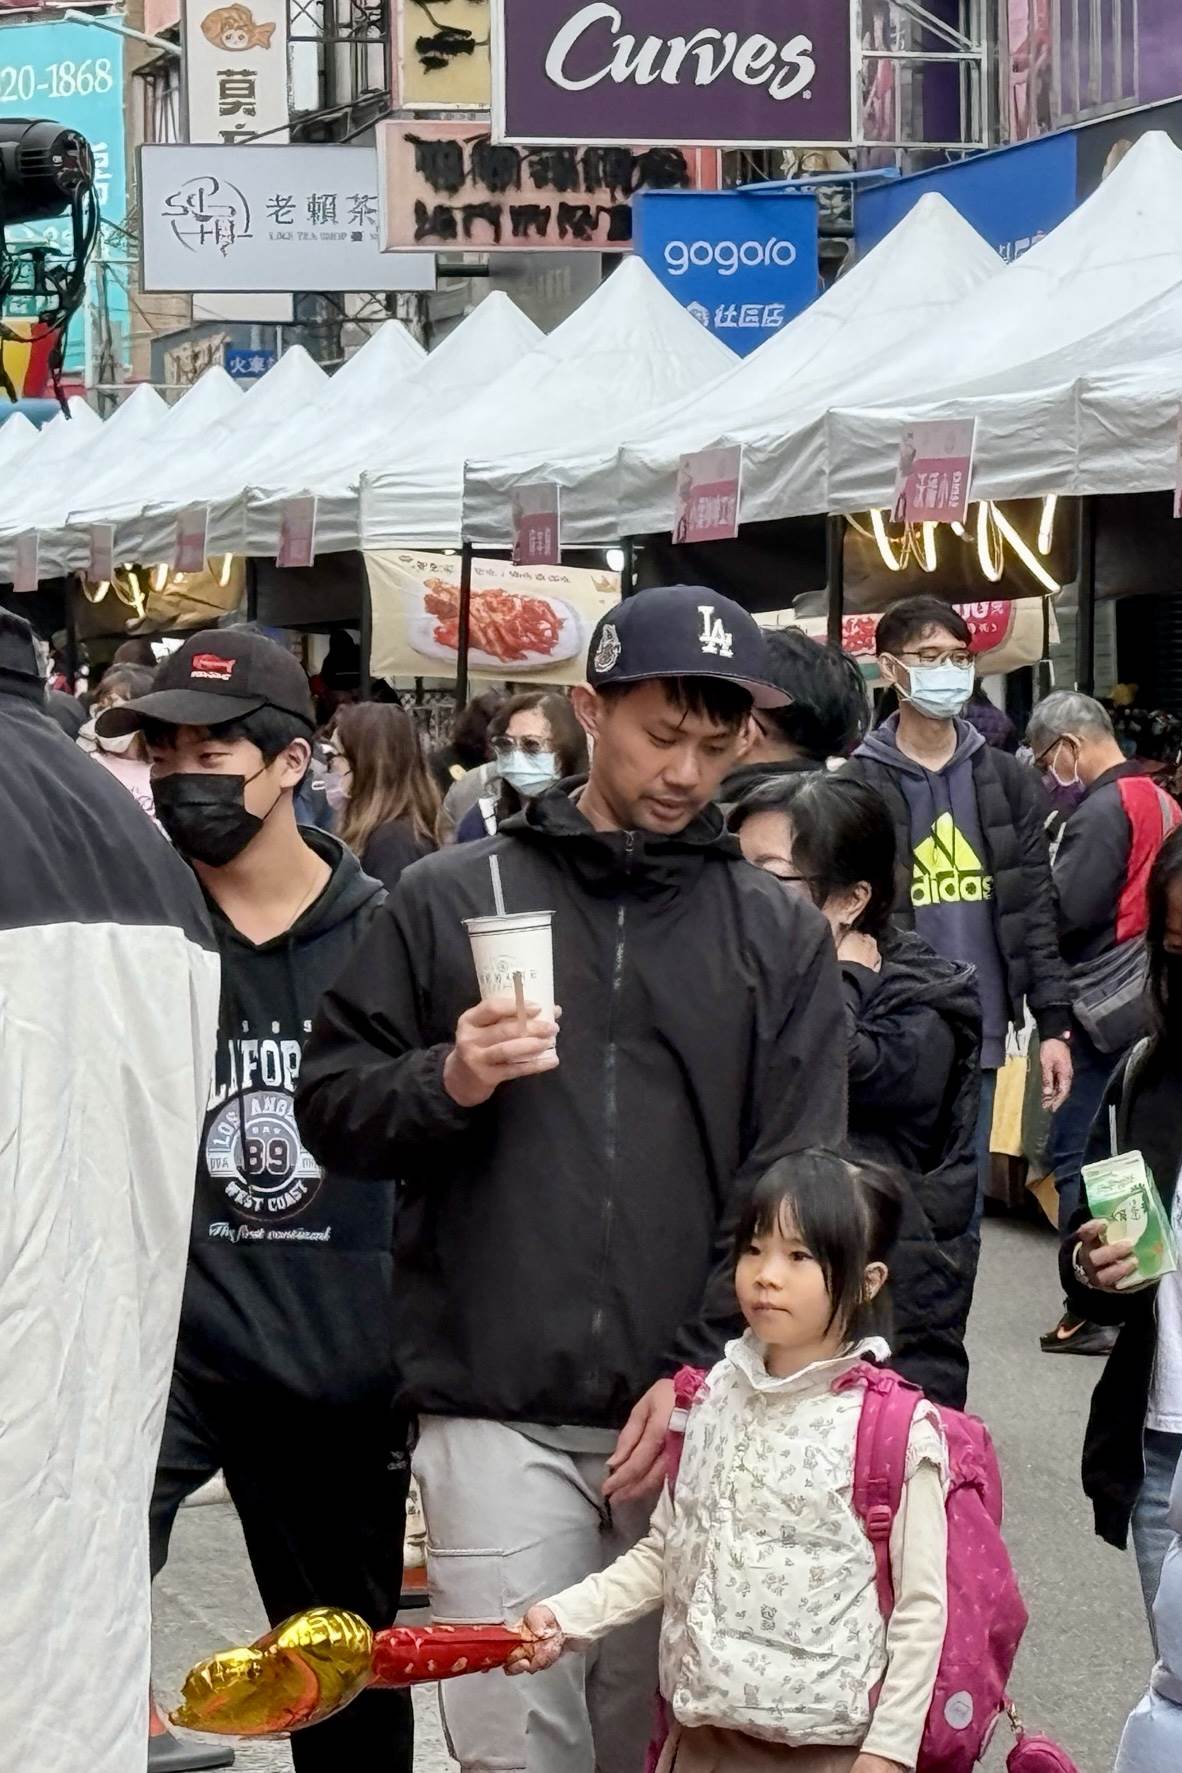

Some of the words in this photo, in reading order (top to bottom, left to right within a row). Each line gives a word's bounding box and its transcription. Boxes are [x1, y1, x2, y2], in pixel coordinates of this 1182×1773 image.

[545, 2, 816, 100] Curves
[0, 57, 113, 102] 20-1868
[664, 238, 797, 277] gogoro
[698, 605, 734, 658] LA
[910, 872, 994, 908] adidas
